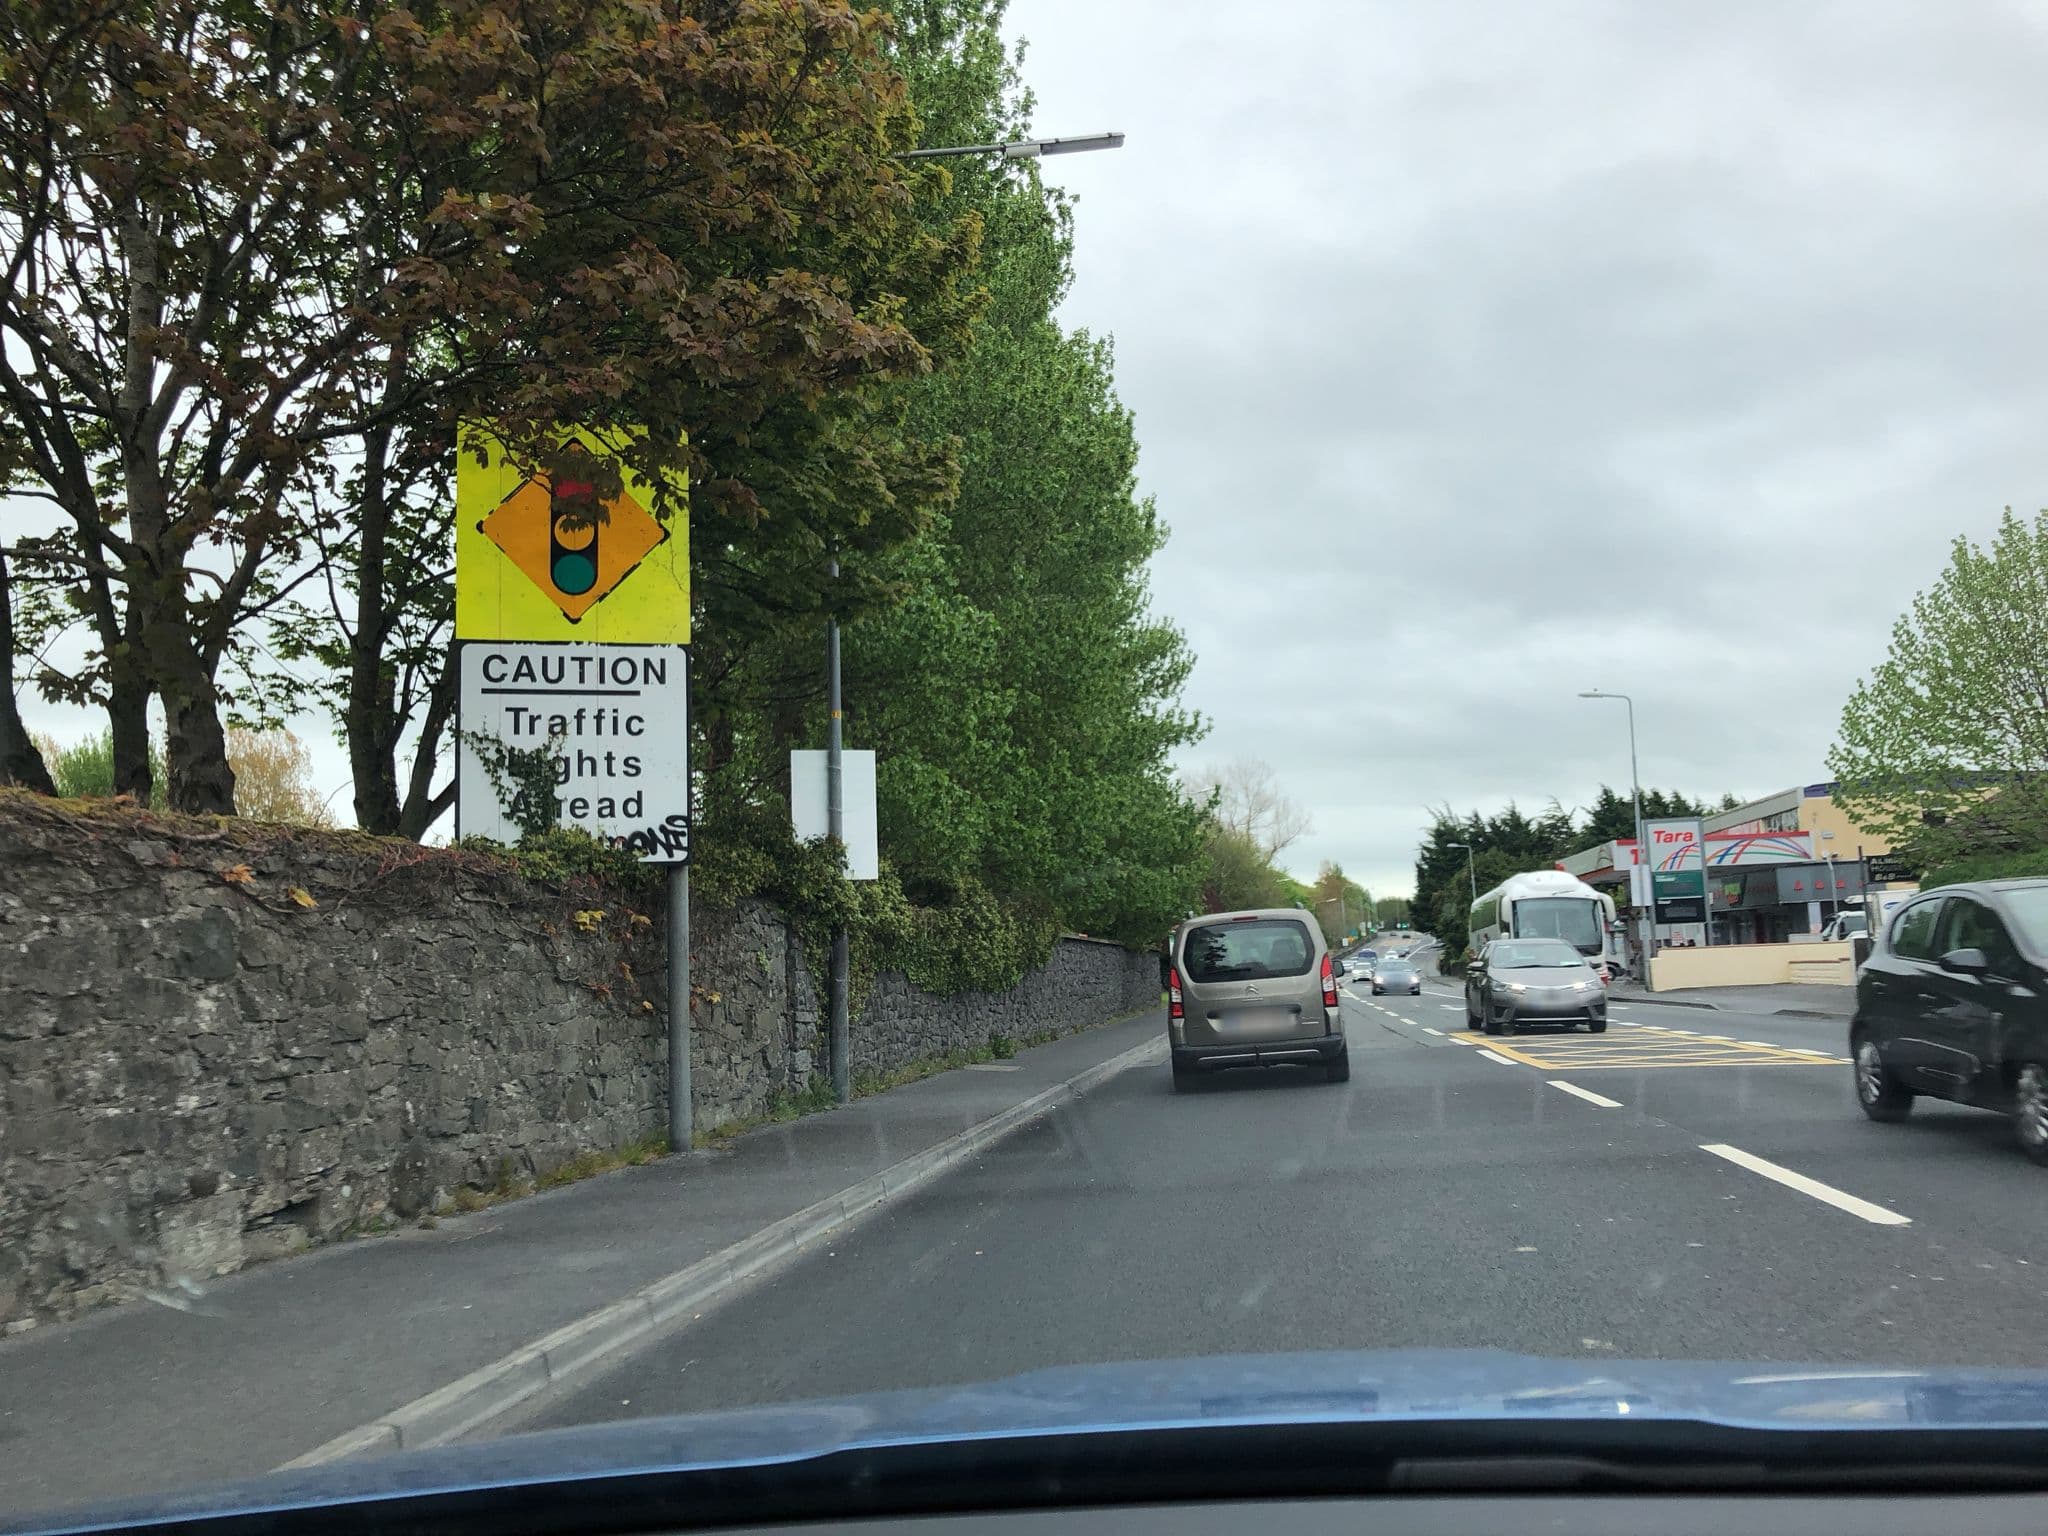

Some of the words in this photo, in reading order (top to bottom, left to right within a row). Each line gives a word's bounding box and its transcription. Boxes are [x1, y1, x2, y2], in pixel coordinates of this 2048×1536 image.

[481, 654, 667, 686] CAUTION
[505, 707, 646, 737] Traffic
[508, 749, 642, 785] ghts
[511, 790, 643, 819] Aead
[1653, 829, 1694, 844] Tara
